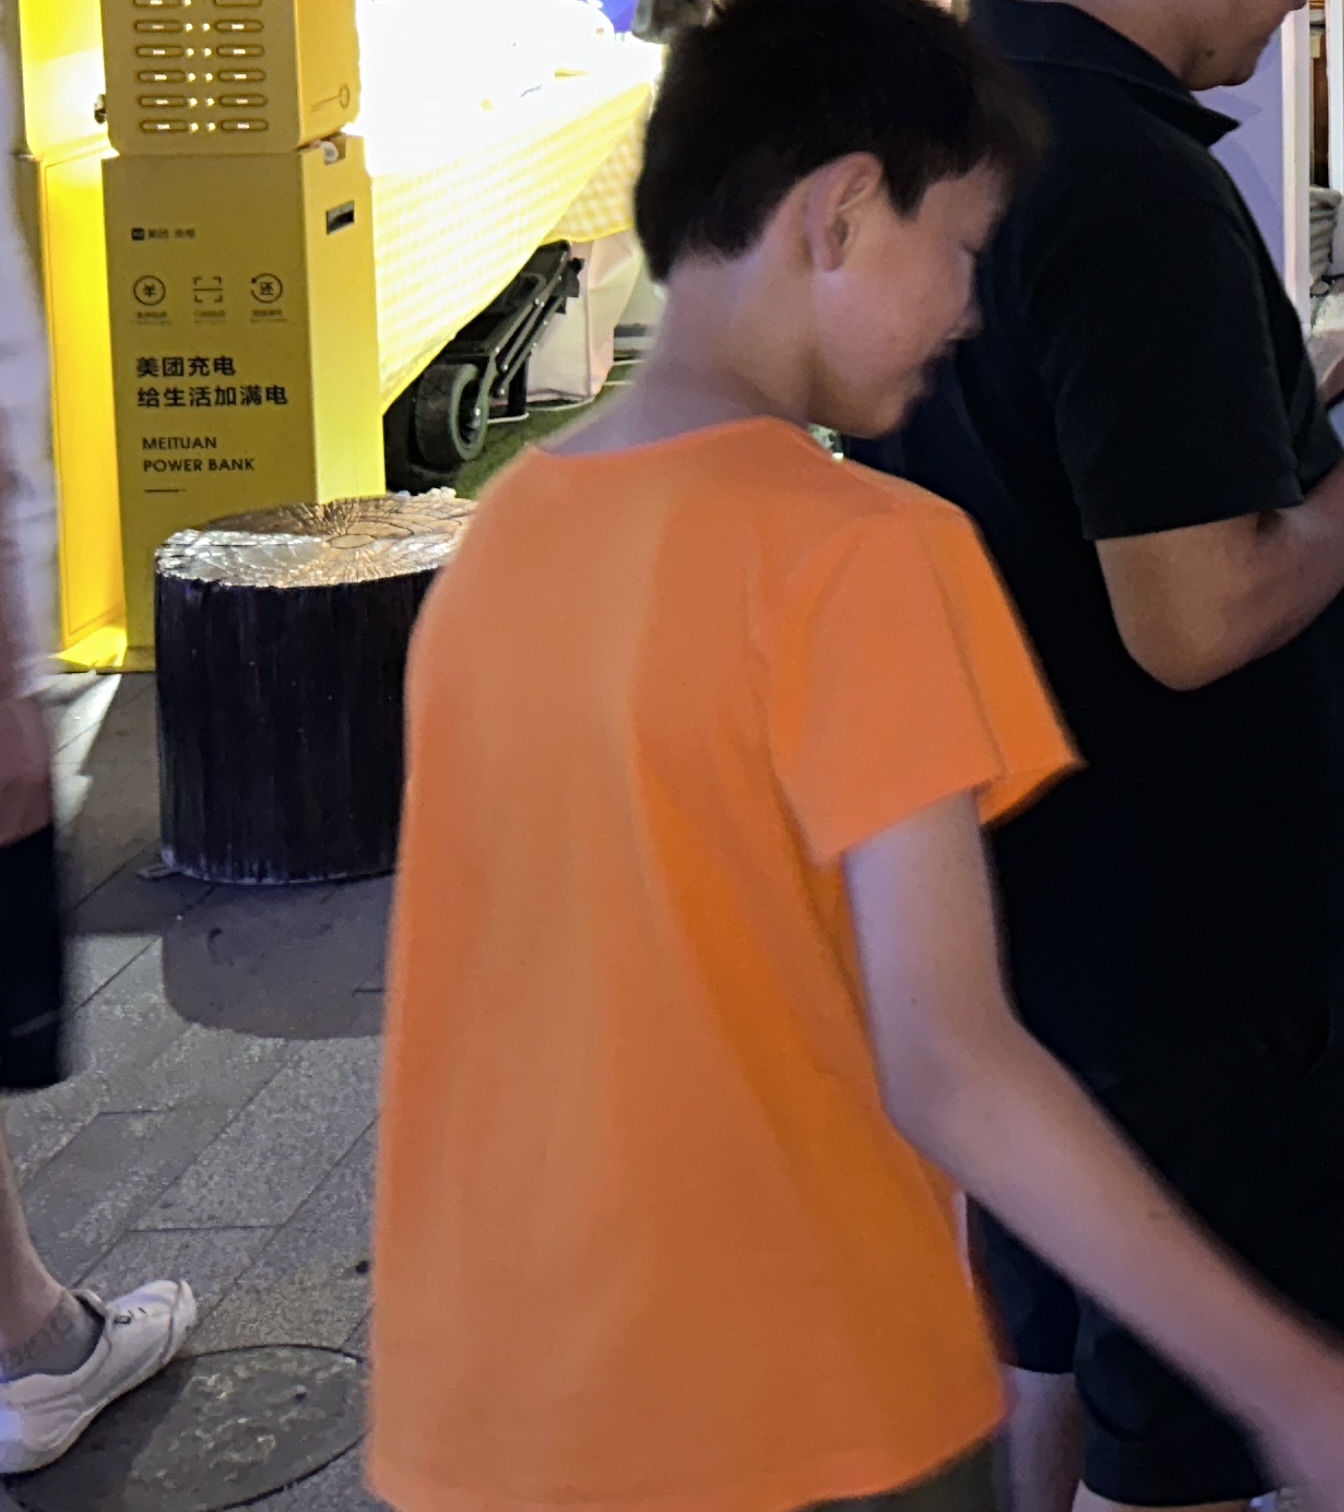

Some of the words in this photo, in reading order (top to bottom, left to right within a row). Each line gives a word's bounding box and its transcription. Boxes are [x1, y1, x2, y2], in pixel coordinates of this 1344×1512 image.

[136, 356, 237, 378] 美团充电
[137, 384, 288, 408] 给生活加满电
[142, 437, 217, 450] MEITUAN
[143, 459, 203, 473] POWER
[208, 458, 255, 472] BANK
